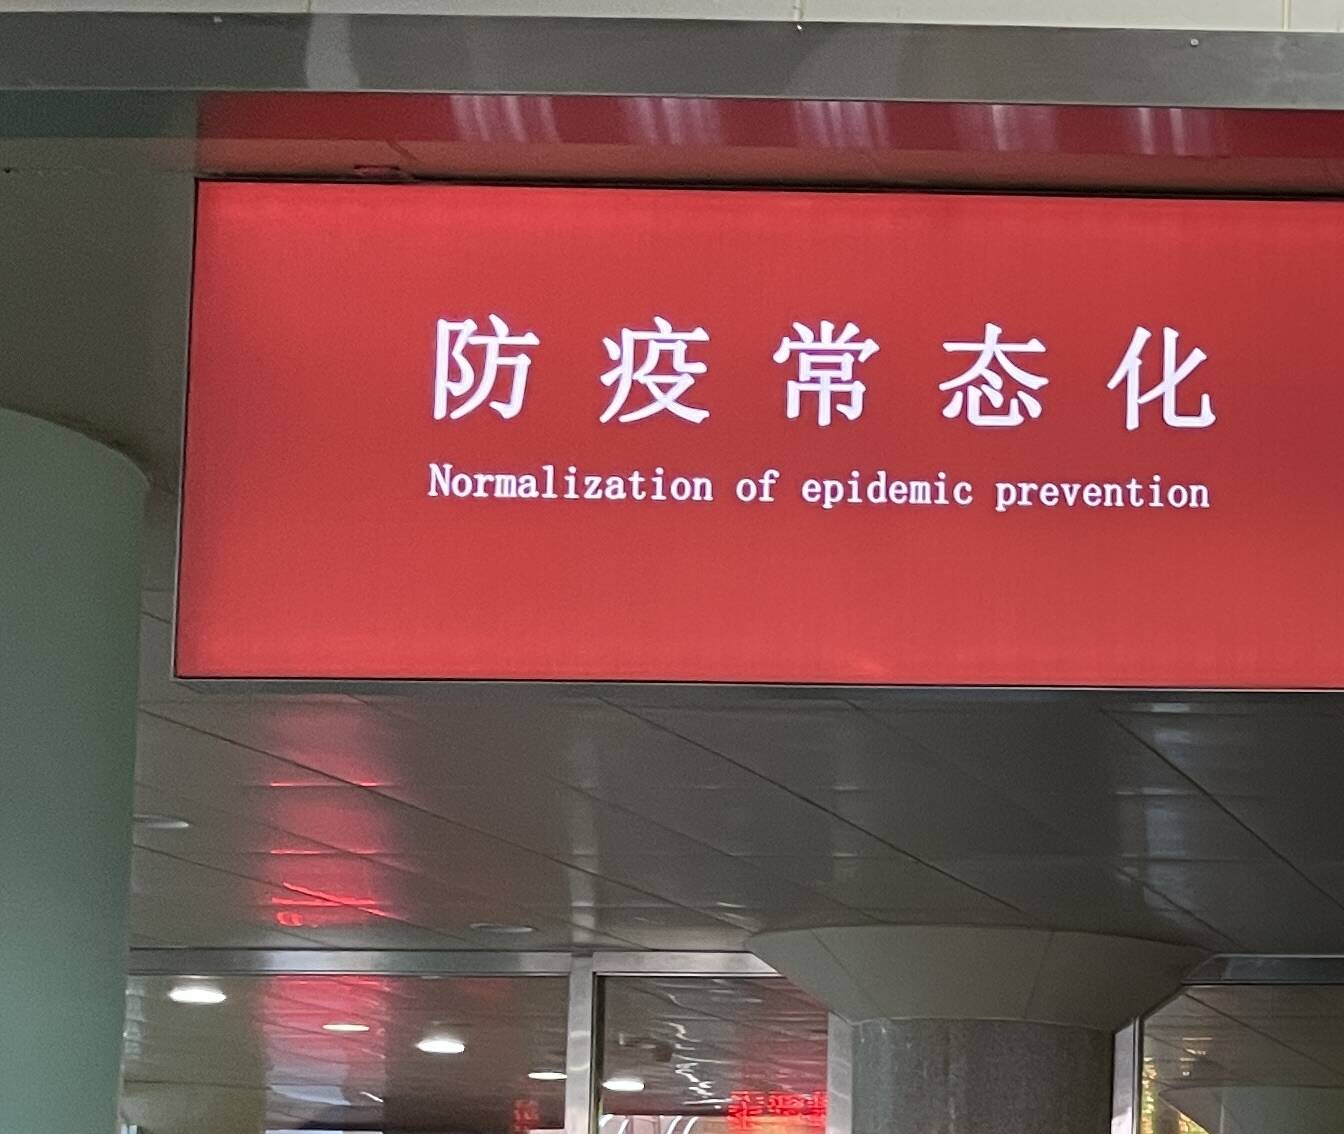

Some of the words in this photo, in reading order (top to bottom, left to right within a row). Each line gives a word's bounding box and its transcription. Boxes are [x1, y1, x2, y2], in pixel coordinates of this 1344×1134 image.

[431, 312, 1217, 432] 防疫常态化
[427, 462, 714, 503] Normalization
[734, 468, 781, 503] of
[800, 470, 974, 510] epidemic
[994, 474, 1211, 513] prevention
